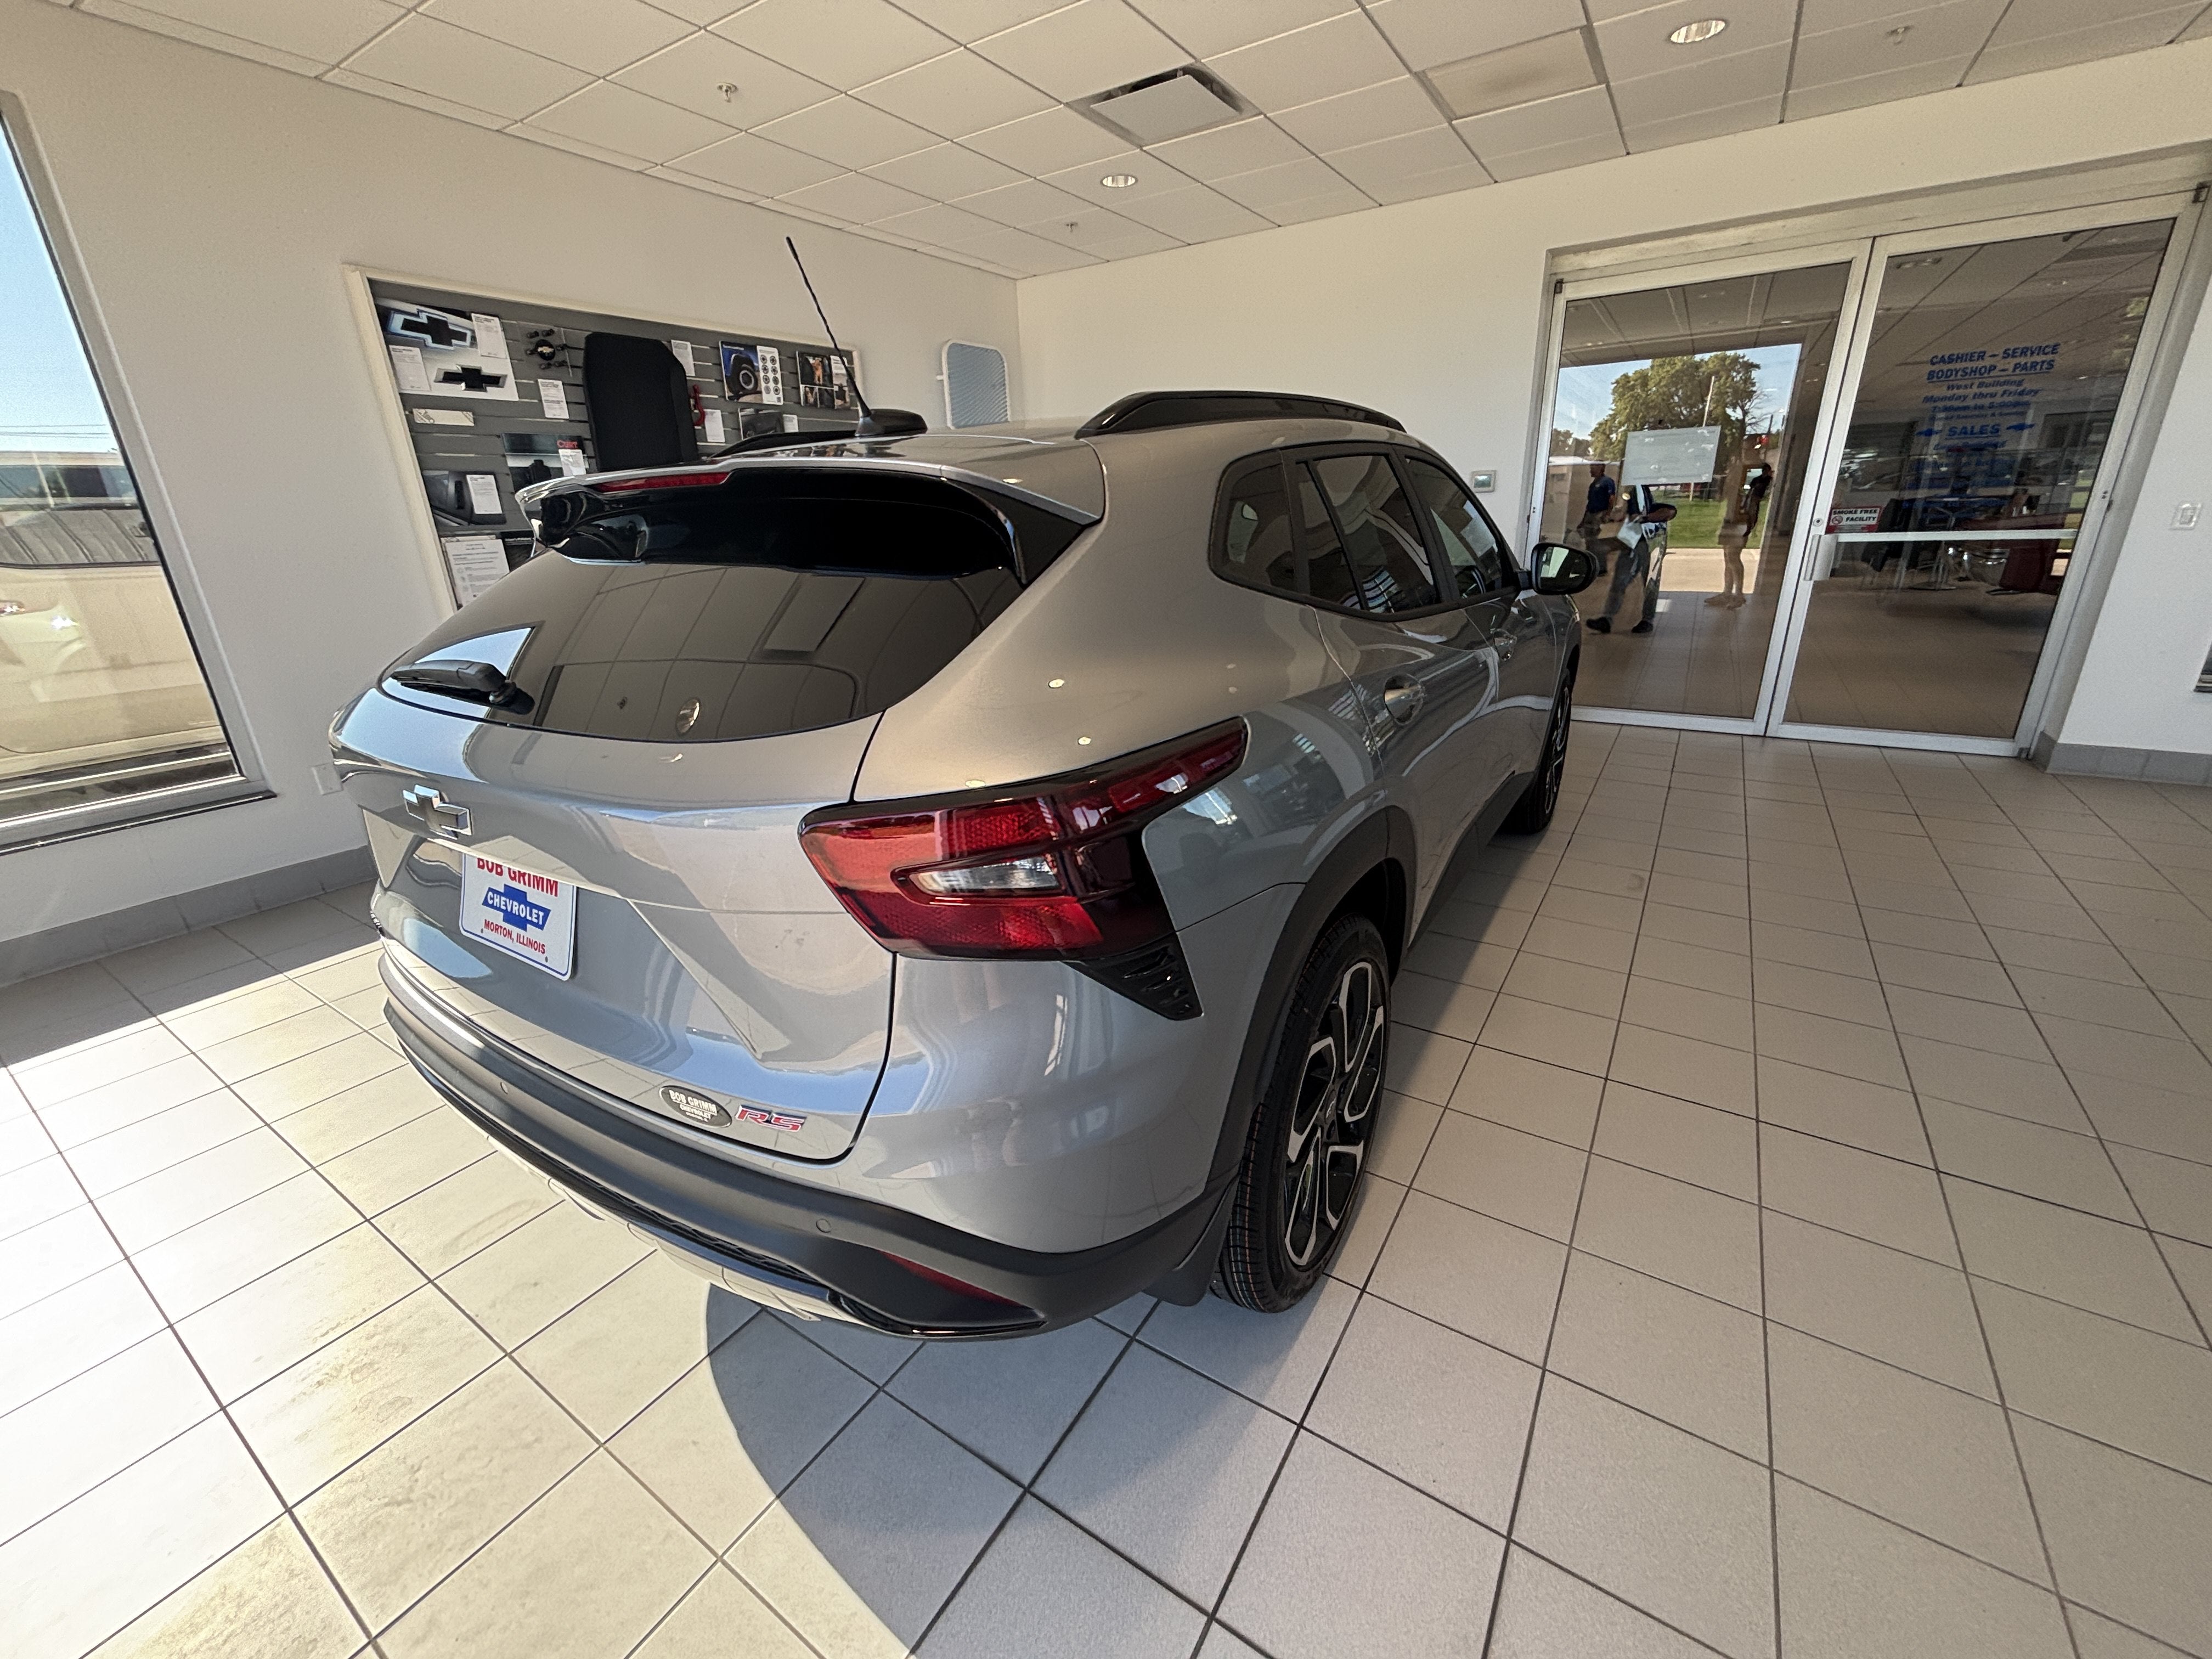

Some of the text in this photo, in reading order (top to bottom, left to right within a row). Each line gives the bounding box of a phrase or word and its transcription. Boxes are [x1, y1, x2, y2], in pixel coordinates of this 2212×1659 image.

[1929, 350, 1987, 365] CASHIER
[2002, 343, 2061, 360] SERVICE
[1927, 364, 1997, 380] BODYSHOP
[2012, 359, 2055, 374] PARTS
[1977, 379, 2025, 390] Building
[1922, 388, 2041, 404] Monday thru Friday
[1948, 424, 2001, 437] SALES
[477, 857, 558, 897] BOB GRIMM
[487, 891, 544, 925] CHEVROLET
[484, 919, 546, 955] MORTON, ILLINOIS
[669, 1090, 718, 1114] BOB GRIMM
[679, 1104, 712, 1120] CHEVROLET
[735, 1105, 806, 1132] RS
